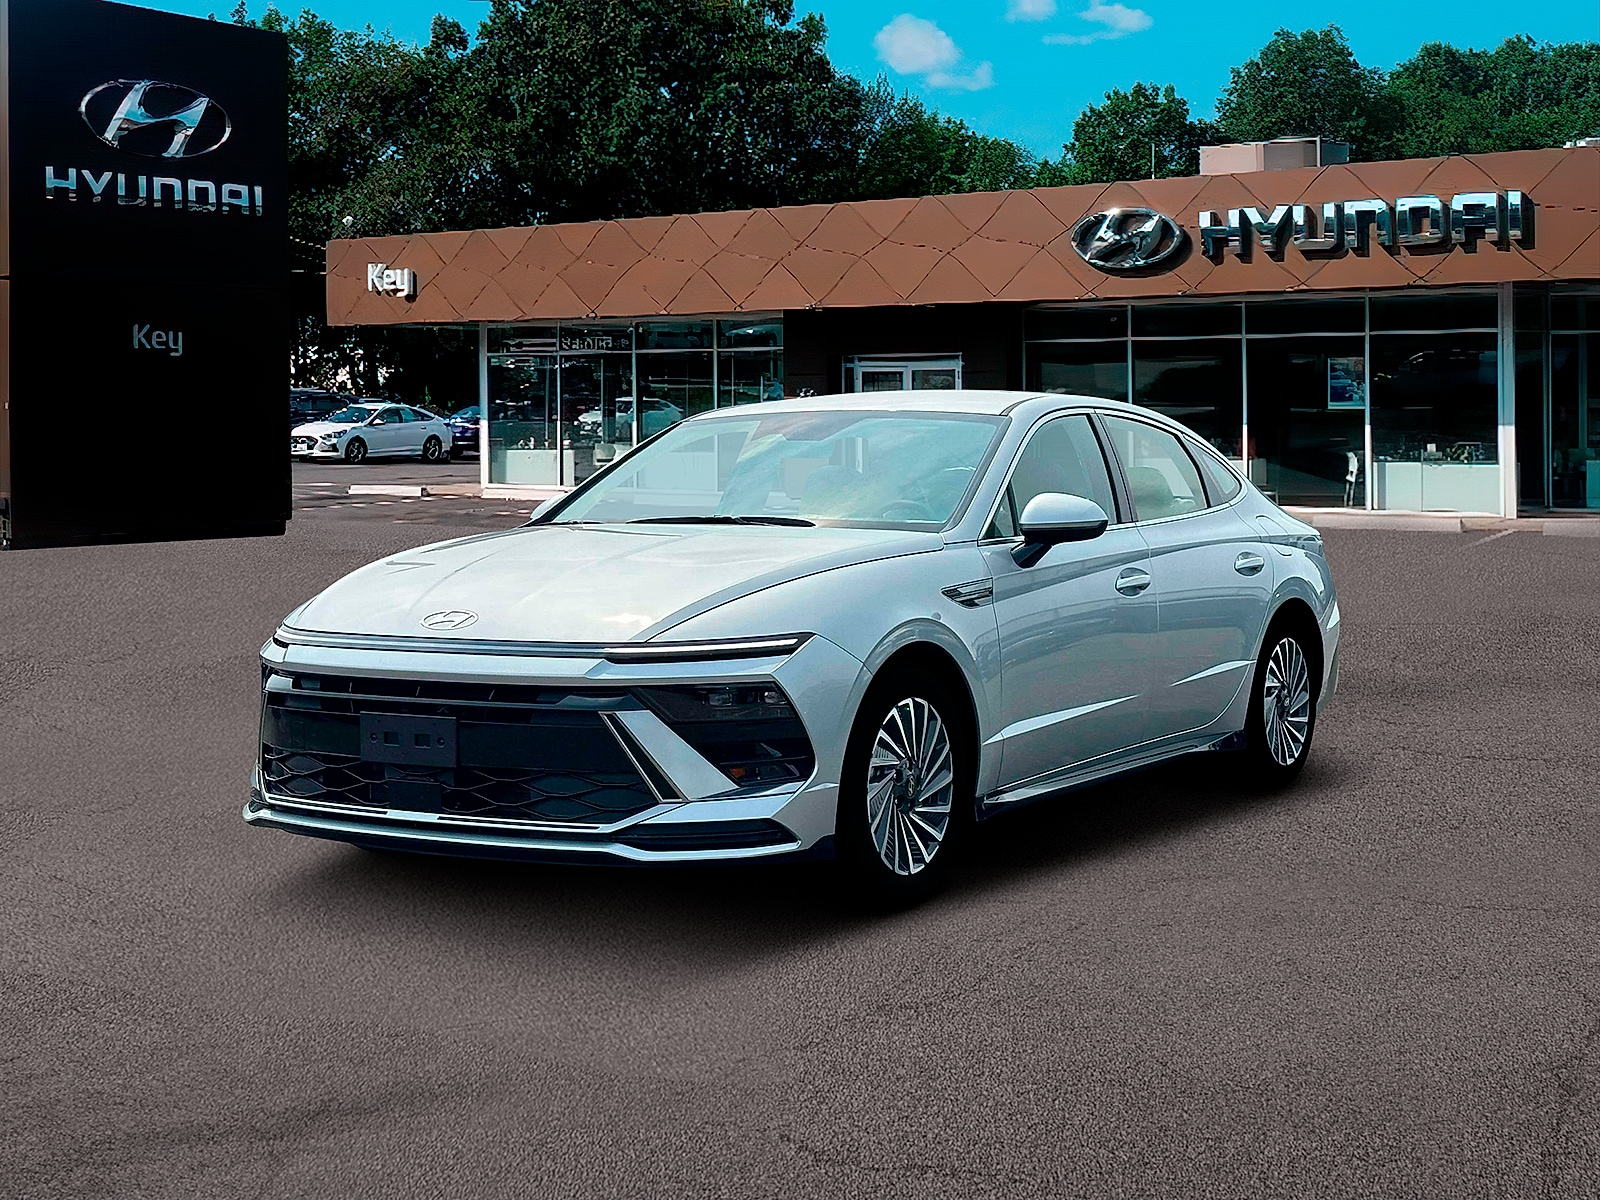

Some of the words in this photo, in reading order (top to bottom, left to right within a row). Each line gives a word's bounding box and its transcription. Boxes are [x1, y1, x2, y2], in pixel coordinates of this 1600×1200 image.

[45, 165, 263, 217] HYUNDAI
[1198, 190, 1534, 264] HYUNDAI
[367, 263, 411, 298] Key
[132, 323, 183, 357] Key
